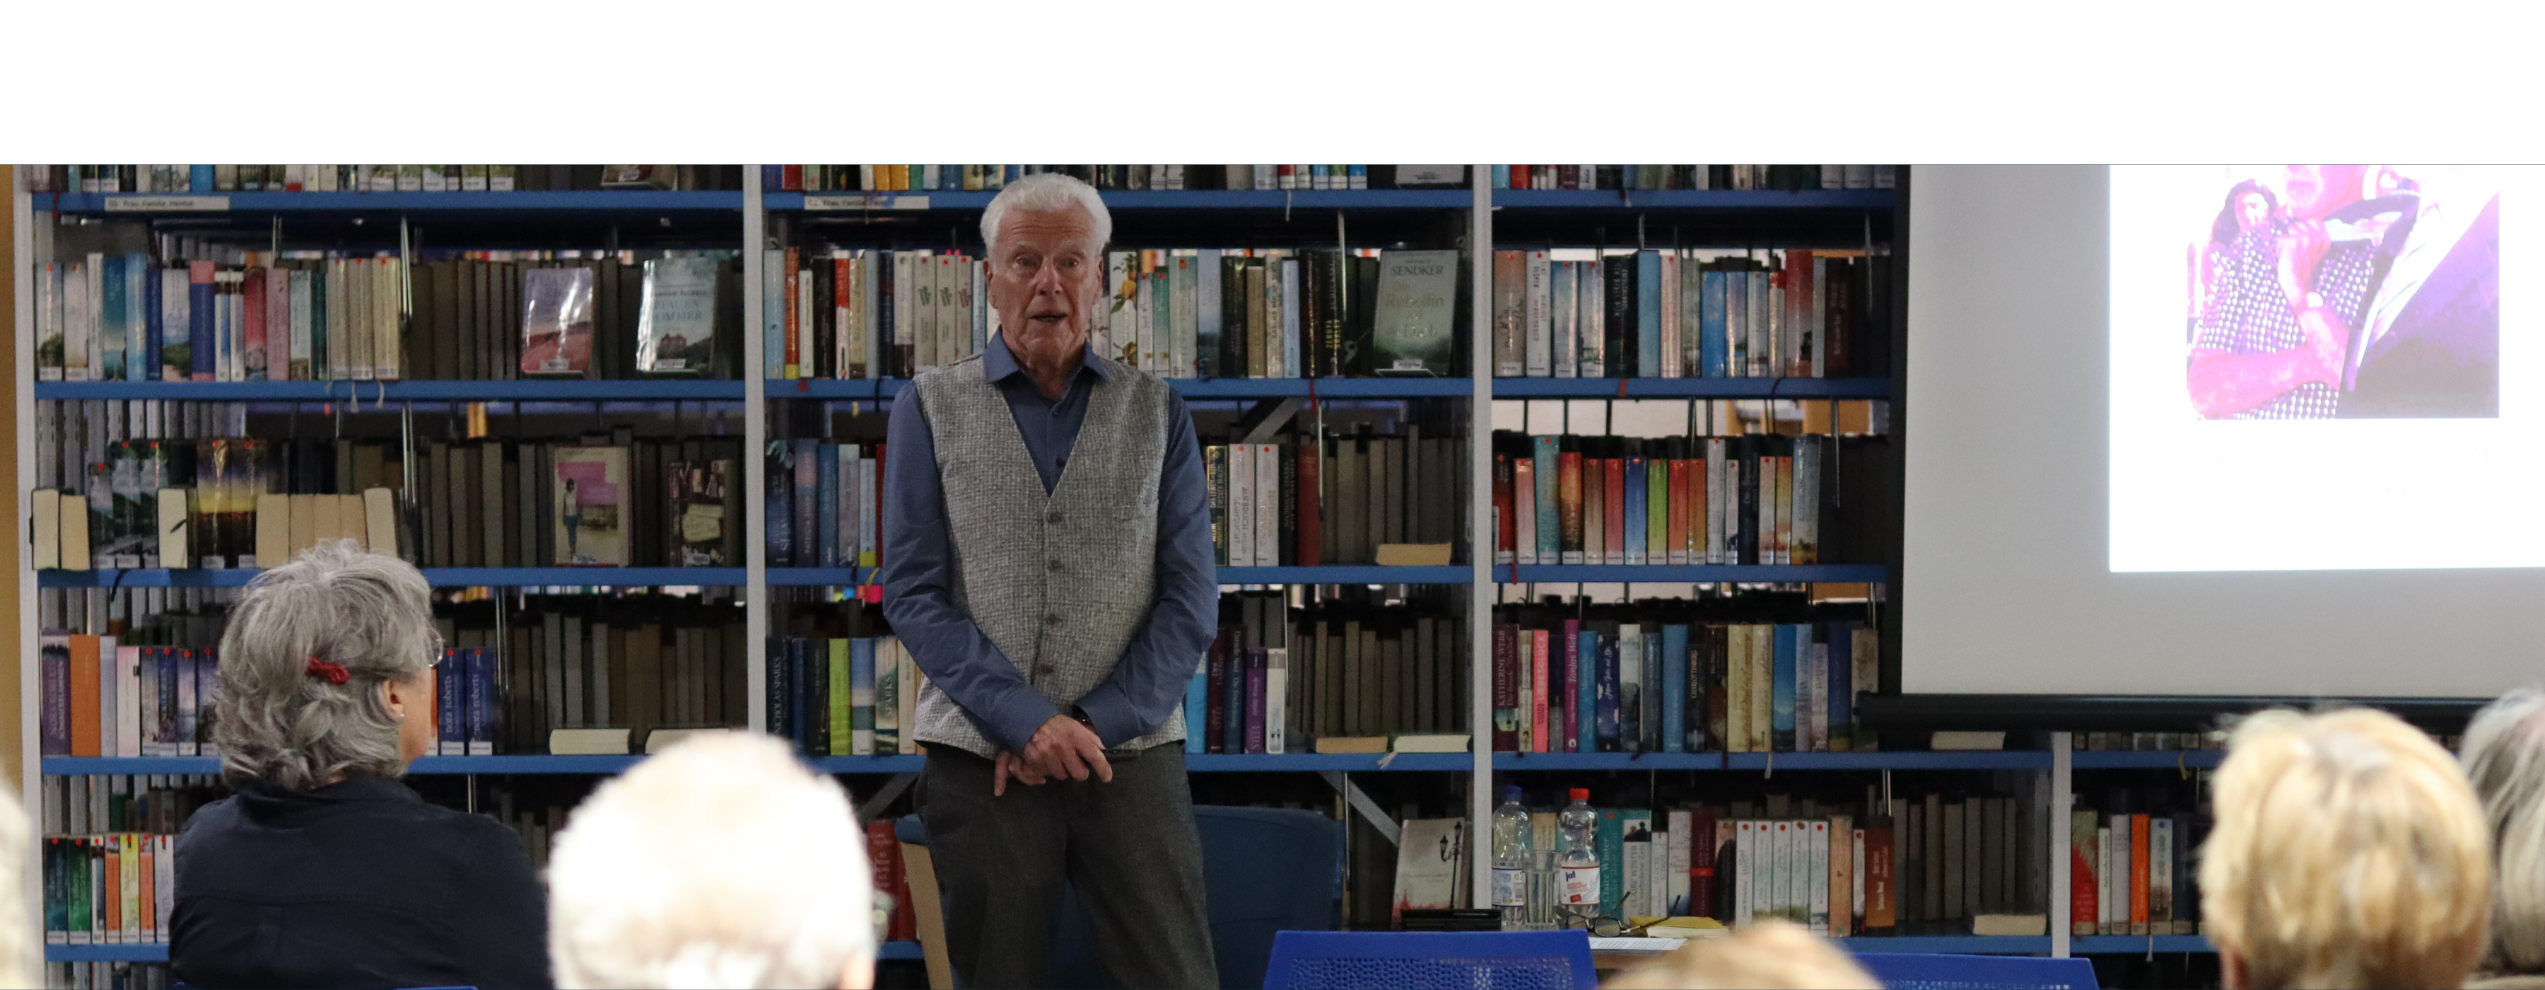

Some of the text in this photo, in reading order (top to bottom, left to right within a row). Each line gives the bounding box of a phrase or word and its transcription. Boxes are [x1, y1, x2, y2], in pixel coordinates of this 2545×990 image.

[1391, 265, 1444, 276] SENDKER
[1568, 633, 1577, 683] Tanjas Welt
[443, 675, 452, 709] roberts
[471, 674, 480, 731] nora roberts
[884, 676, 893, 717] SPARKS
[1602, 837, 1610, 870] Winter
[1565, 871, 1576, 882] ja!
